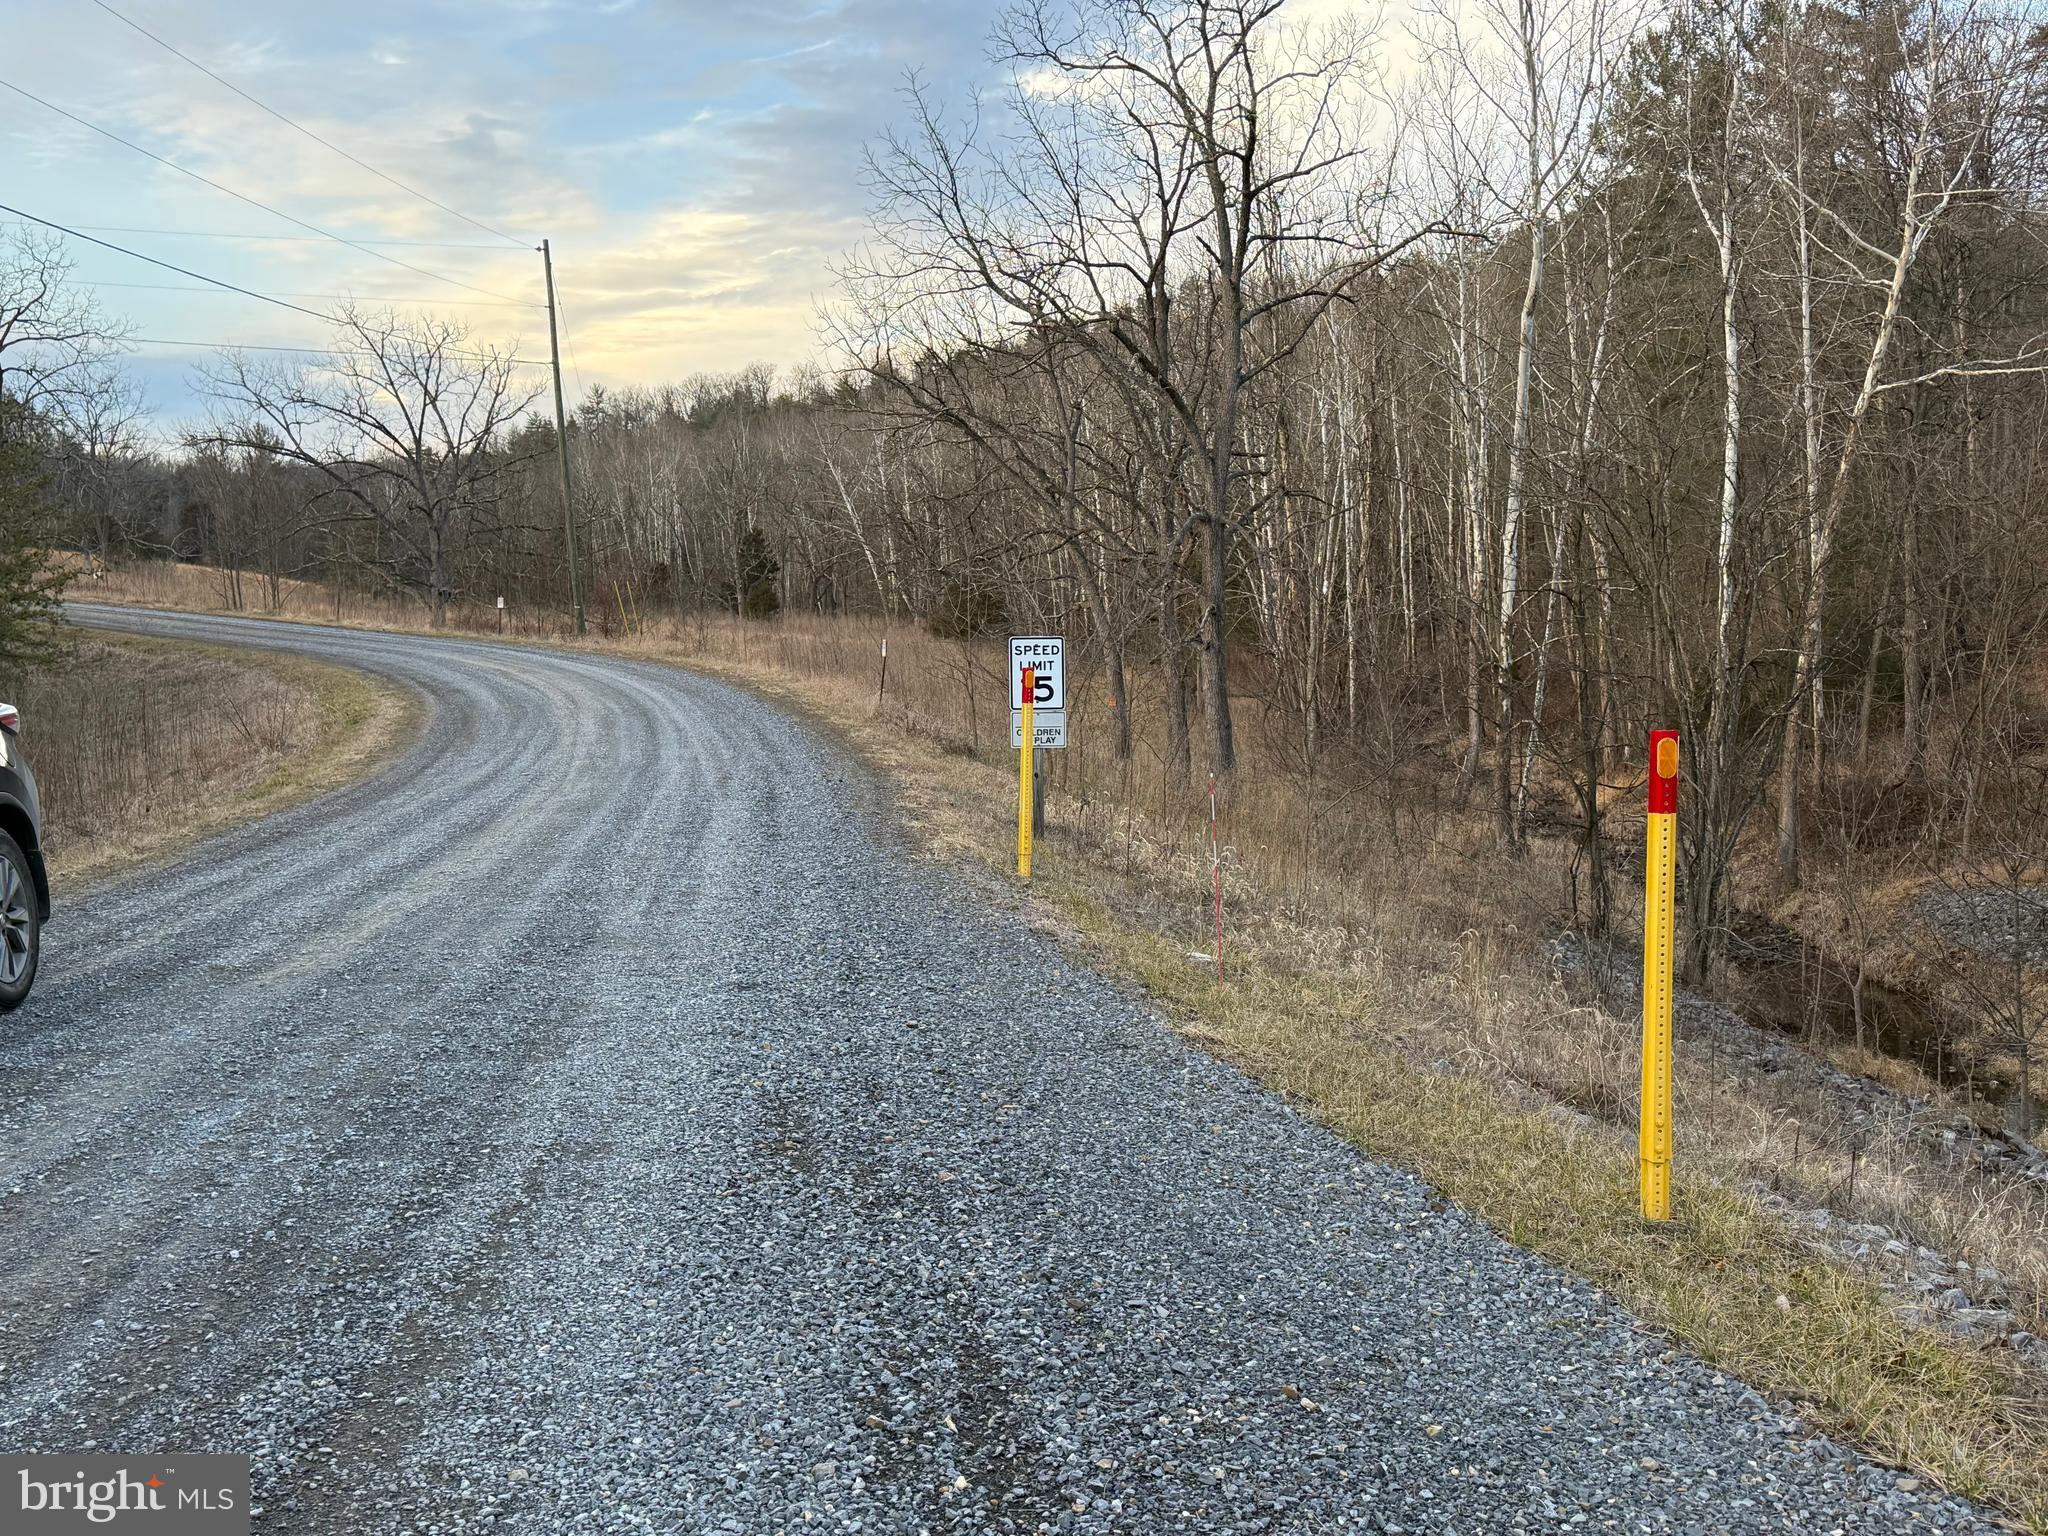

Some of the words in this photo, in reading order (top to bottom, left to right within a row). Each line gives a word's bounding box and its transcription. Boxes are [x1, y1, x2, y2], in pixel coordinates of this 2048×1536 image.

[1014, 645, 1060, 656] SPEED
[1021, 676, 1054, 702] 5
[1034, 736, 1057, 744] PLAY
